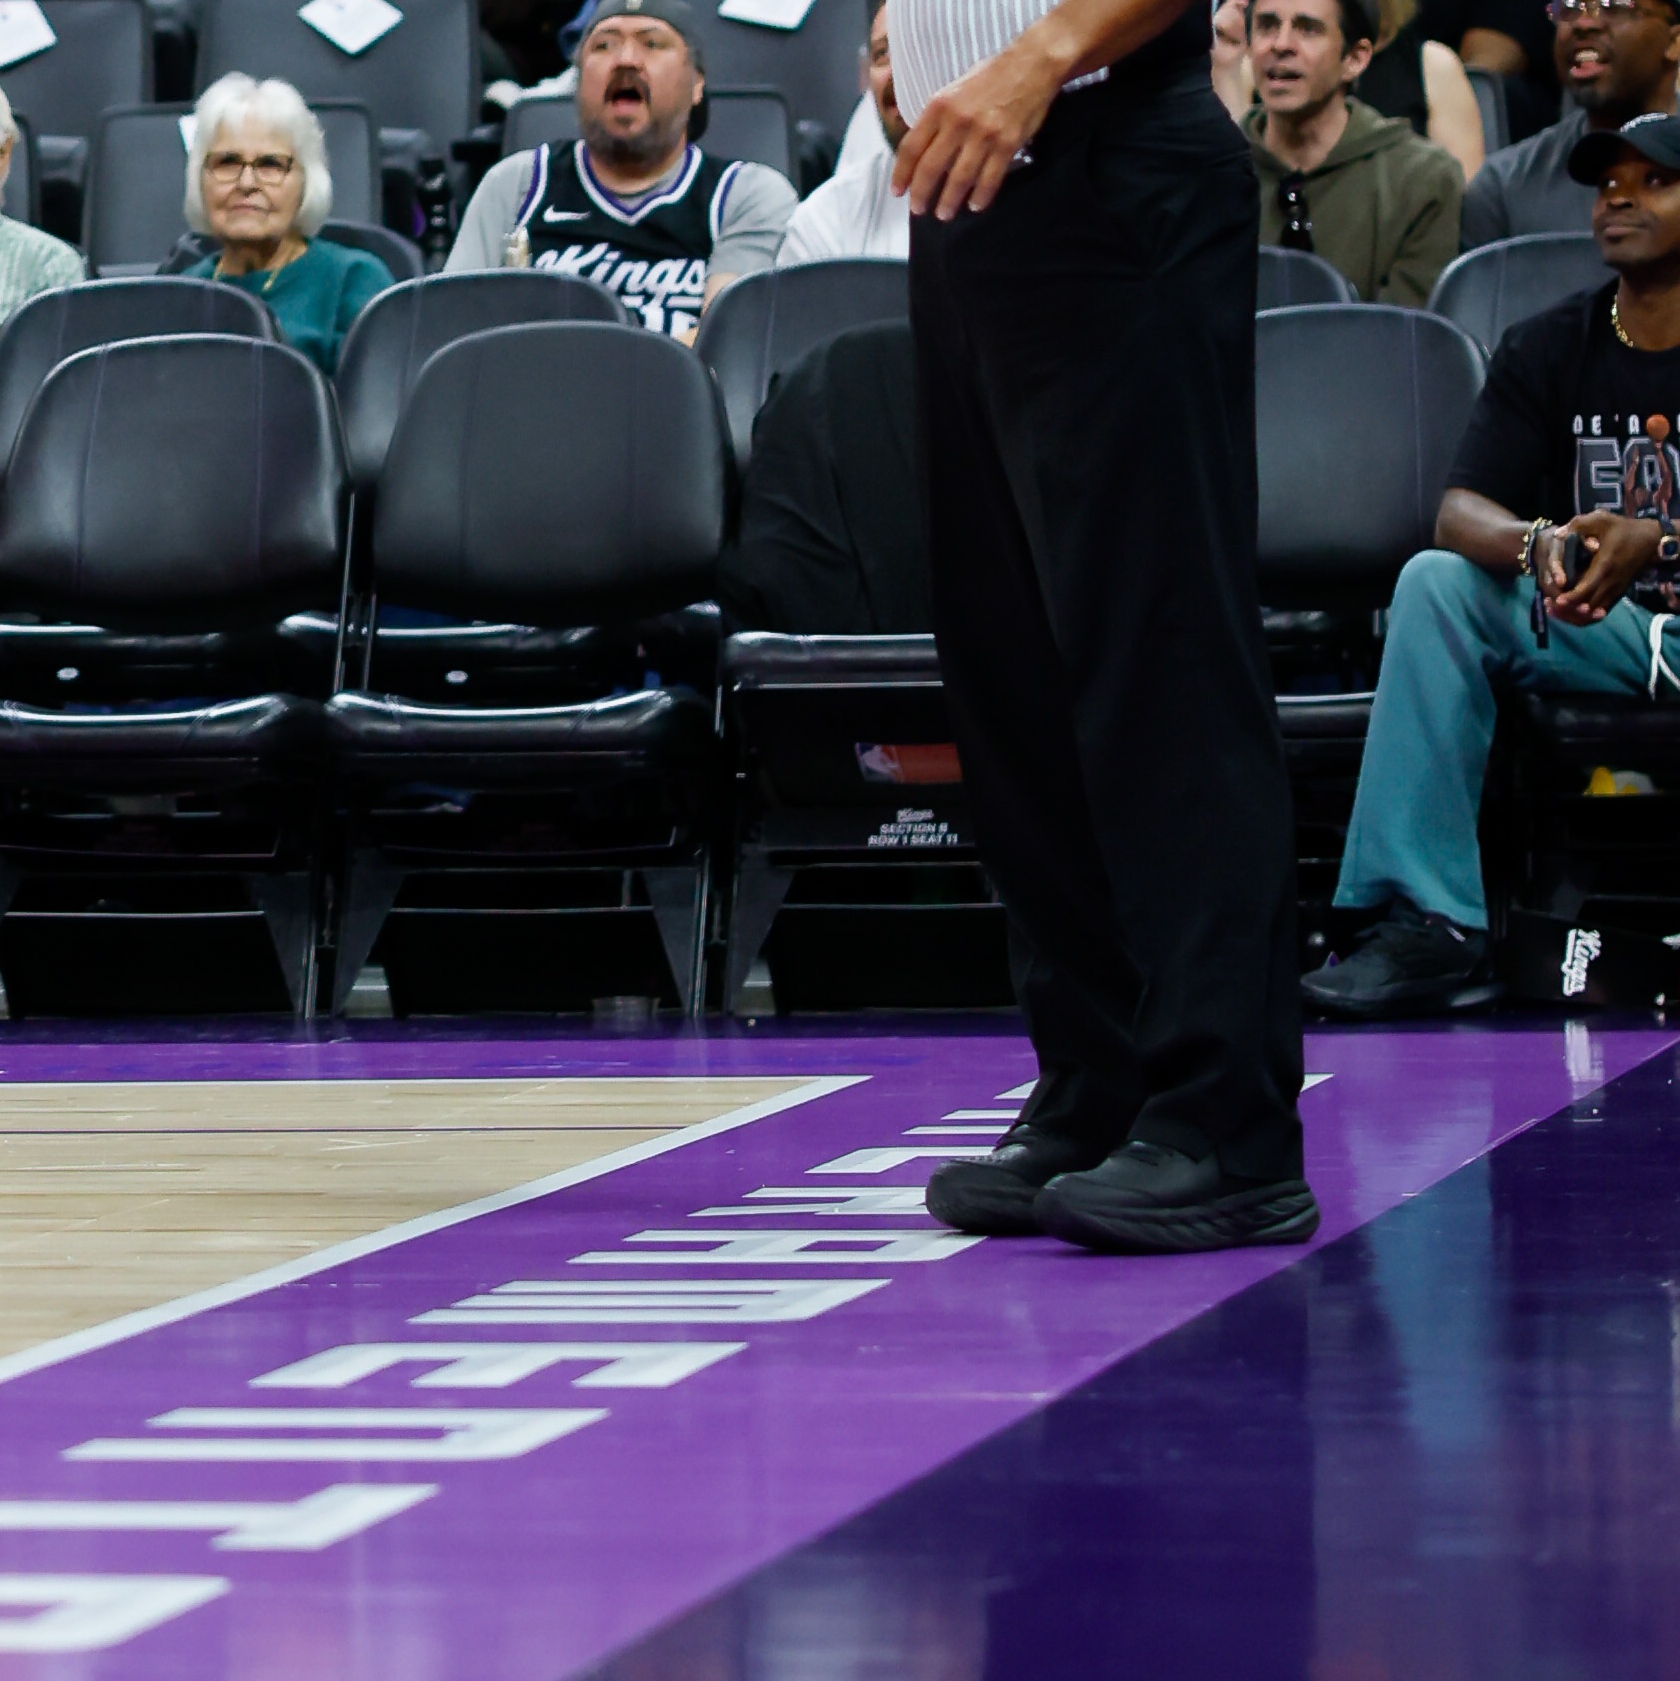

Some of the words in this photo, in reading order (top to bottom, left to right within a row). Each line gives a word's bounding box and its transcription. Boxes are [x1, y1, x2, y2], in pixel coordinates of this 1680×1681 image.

[533, 241, 707, 309] Kings
[879, 823, 937, 835] SECTION
[1561, 928, 1602, 997] Kings
